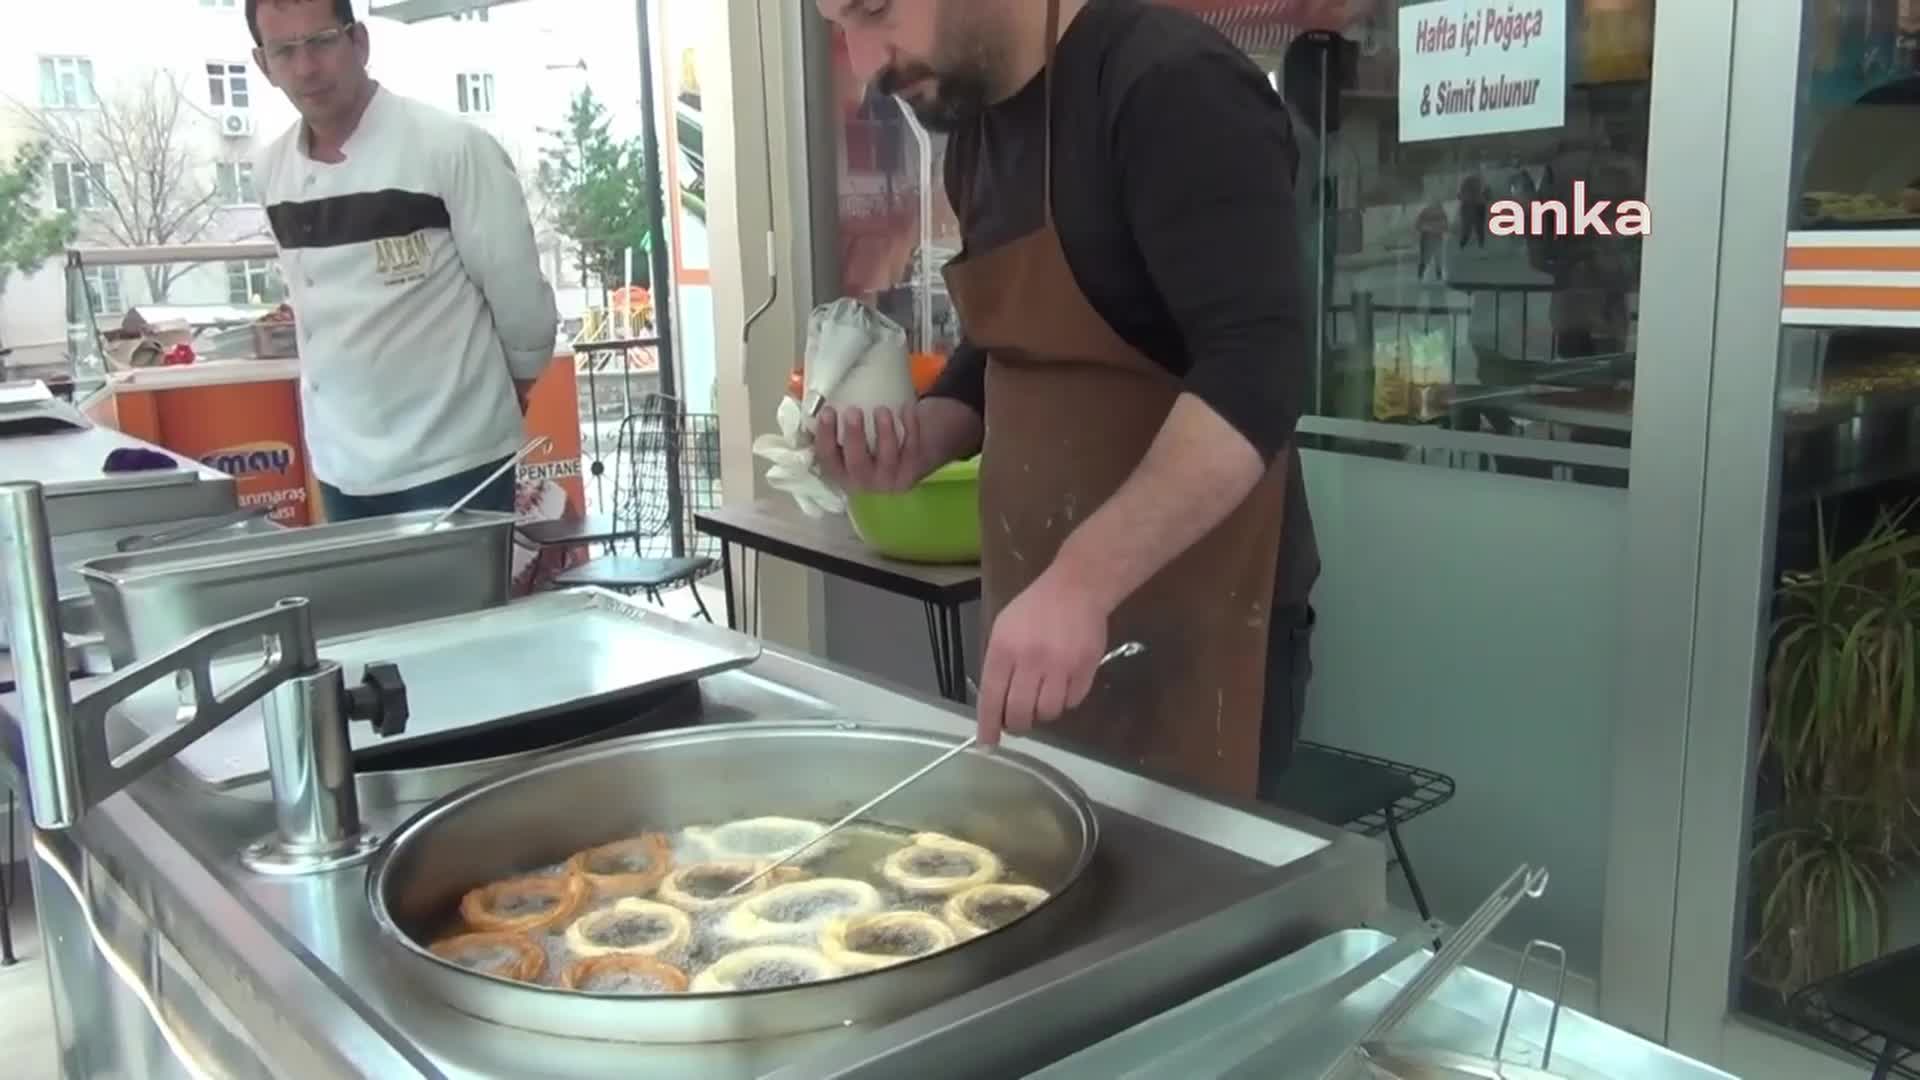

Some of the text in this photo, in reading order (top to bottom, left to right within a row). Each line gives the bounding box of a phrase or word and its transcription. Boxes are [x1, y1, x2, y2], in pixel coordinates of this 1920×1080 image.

[1416, 5, 1543, 56] Hafta içi Poğaça
[1420, 74, 1540, 117] & Simit bulunur
